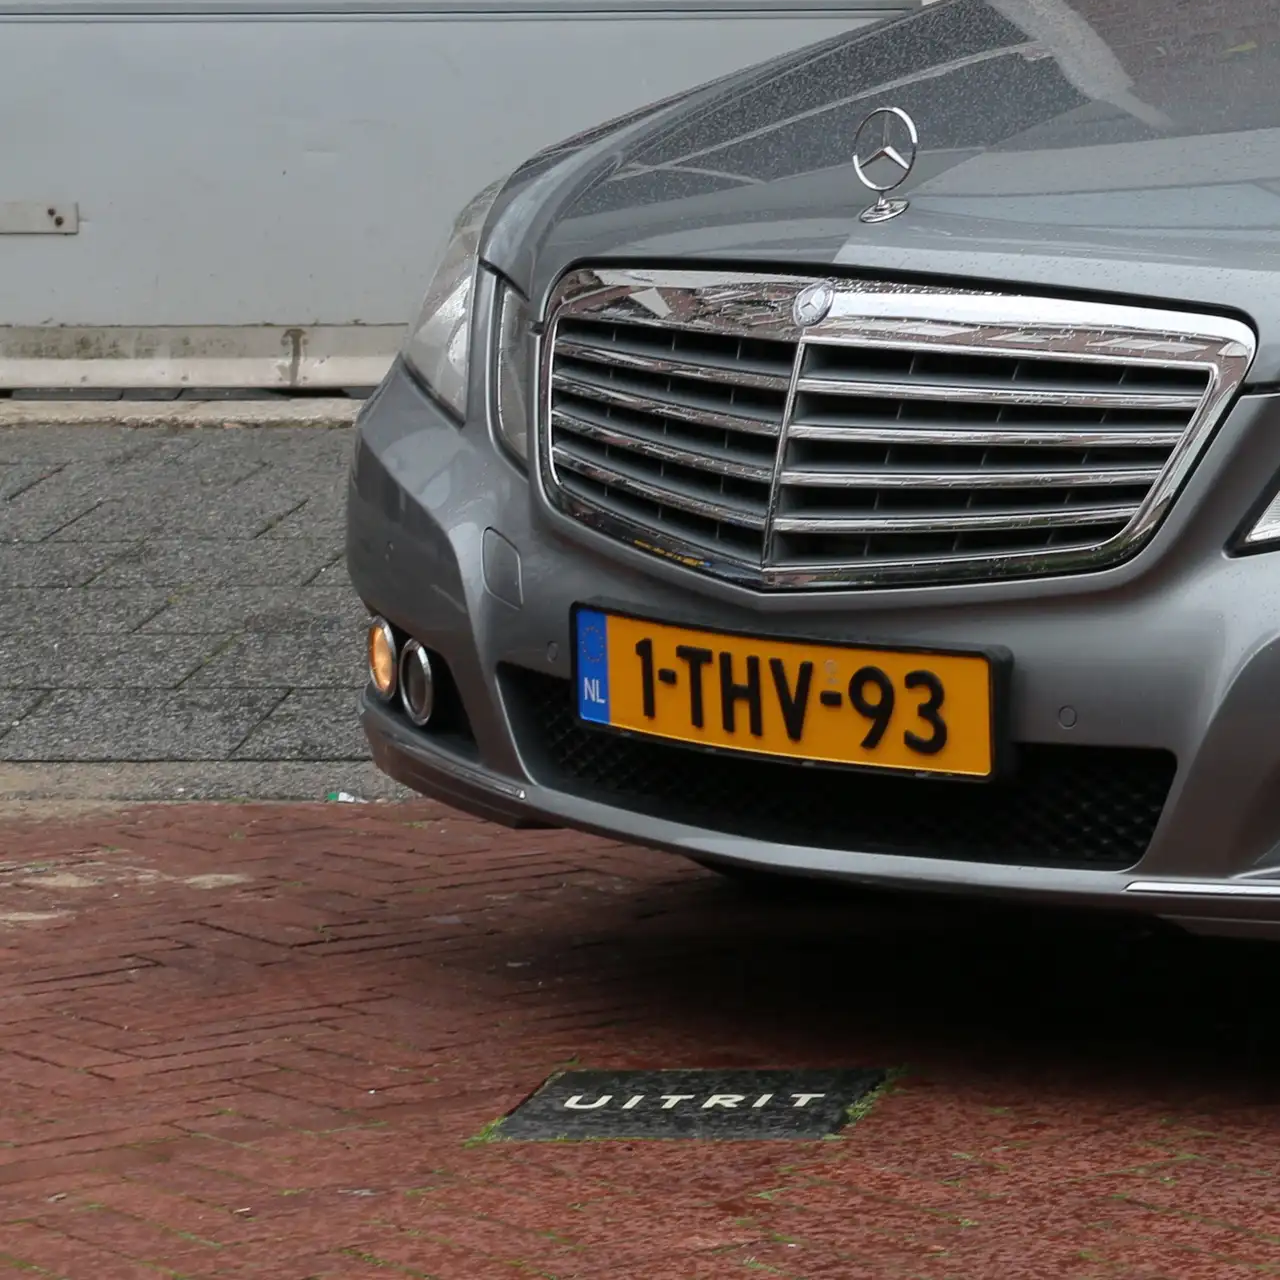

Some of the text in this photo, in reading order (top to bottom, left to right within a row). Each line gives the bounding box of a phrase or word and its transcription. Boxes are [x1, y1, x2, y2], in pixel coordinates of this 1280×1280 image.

[583, 676, 606, 704] NL
[635, 637, 948, 755] 1-THV-93
[563, 1092, 826, 1110] UITRIT
